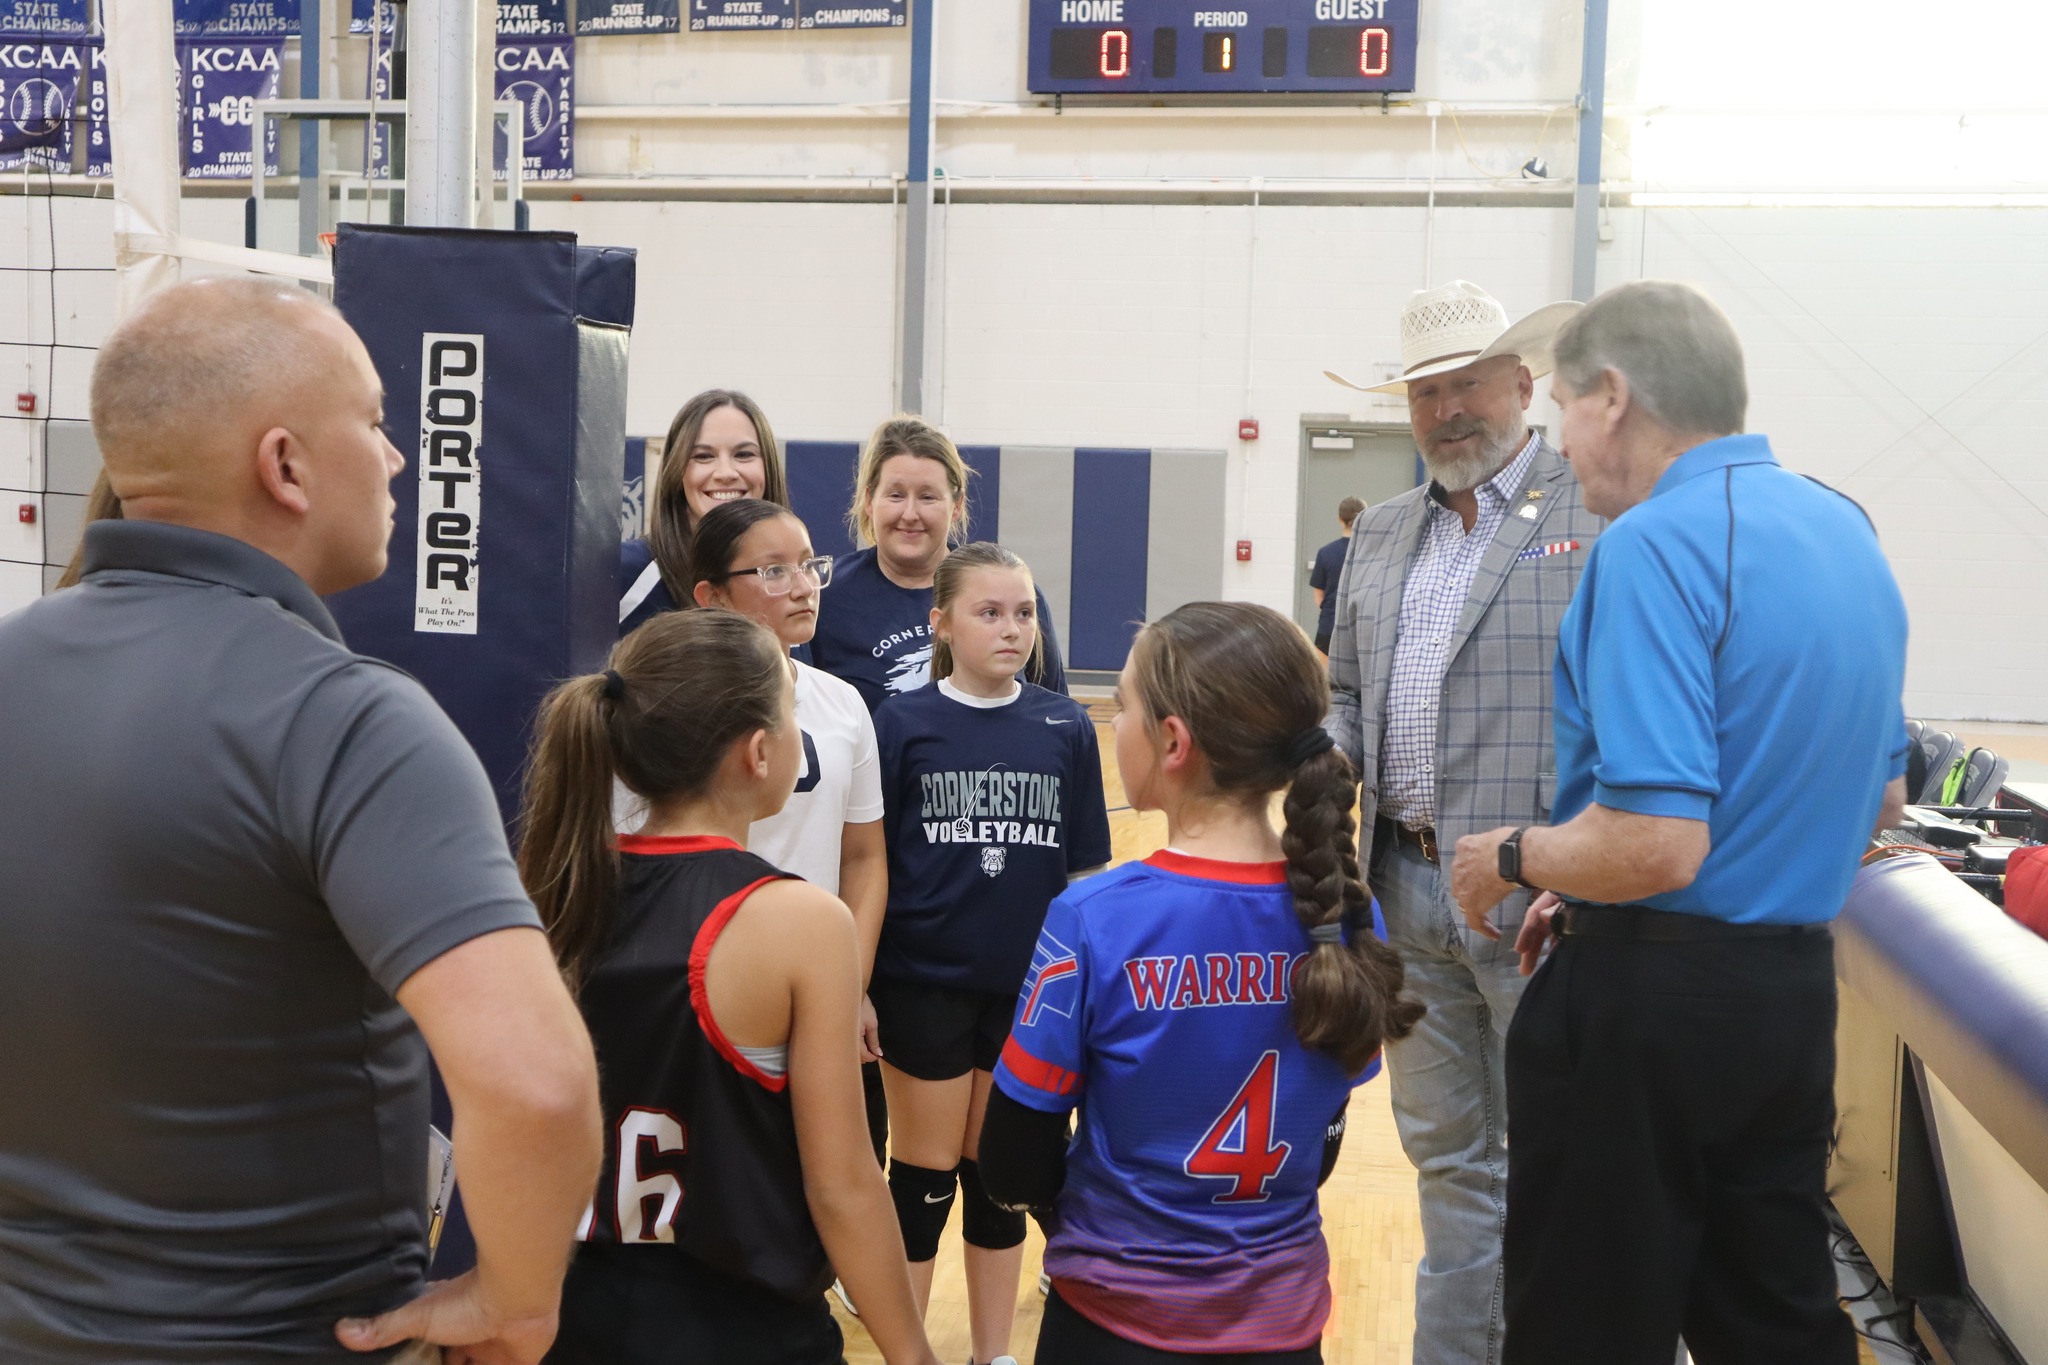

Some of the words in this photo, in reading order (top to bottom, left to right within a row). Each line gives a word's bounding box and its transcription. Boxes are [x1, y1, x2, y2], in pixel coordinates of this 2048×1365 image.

[14, 3, 58, 17] STATE
[230, 3, 274, 17] STATE
[611, 3, 644, 16] STATE
[723, 2, 763, 14] STATE
[1062, 0, 1124, 22] HOME
[1315, 0, 1386, 20] GUEST
[3, 15, 71, 31] CHAMPS
[219, 17, 287, 32] CHAMPS
[578, 20, 592, 31] 20
[592, 15, 663, 29] RUNNER-UP
[664, 17, 677, 28] 17
[691, 18, 705, 30] 20
[707, 15, 779, 26] RUNNER-UP
[781, 18, 794, 29] 19
[800, 17, 815, 28] 20
[815, 9, 891, 23] CHAMPIONS
[891, 14, 904, 26] 18
[1194, 11, 1247, 27] PERIOD
[552, 22, 565, 33] 12
[1101, 30, 1127, 76] 0
[1222, 37, 1231, 69] 1
[1360, 28, 1388, 74] 0
[191, 47, 281, 72] KCAA
[91, 80, 105, 146] BOYS
[191, 74, 205, 154] GIRLS
[559, 76, 571, 160] VARSITY
[218, 152, 253, 164] STATE
[88, 165, 101, 176] 20
[188, 167, 201, 178] 20
[264, 165, 278, 176] 22
[541, 169, 557, 180] UP
[558, 168, 573, 179] 24
[418, 606, 438, 615] What
[441, 608, 455, 616] The
[457, 608, 475, 617] Pros
[426, 618, 444, 628] Play
[920, 771, 1062, 823] CORNERSTONE
[922, 821, 1060, 848] VOLLEYBALL
[1184, 1049, 1292, 1204] 4
